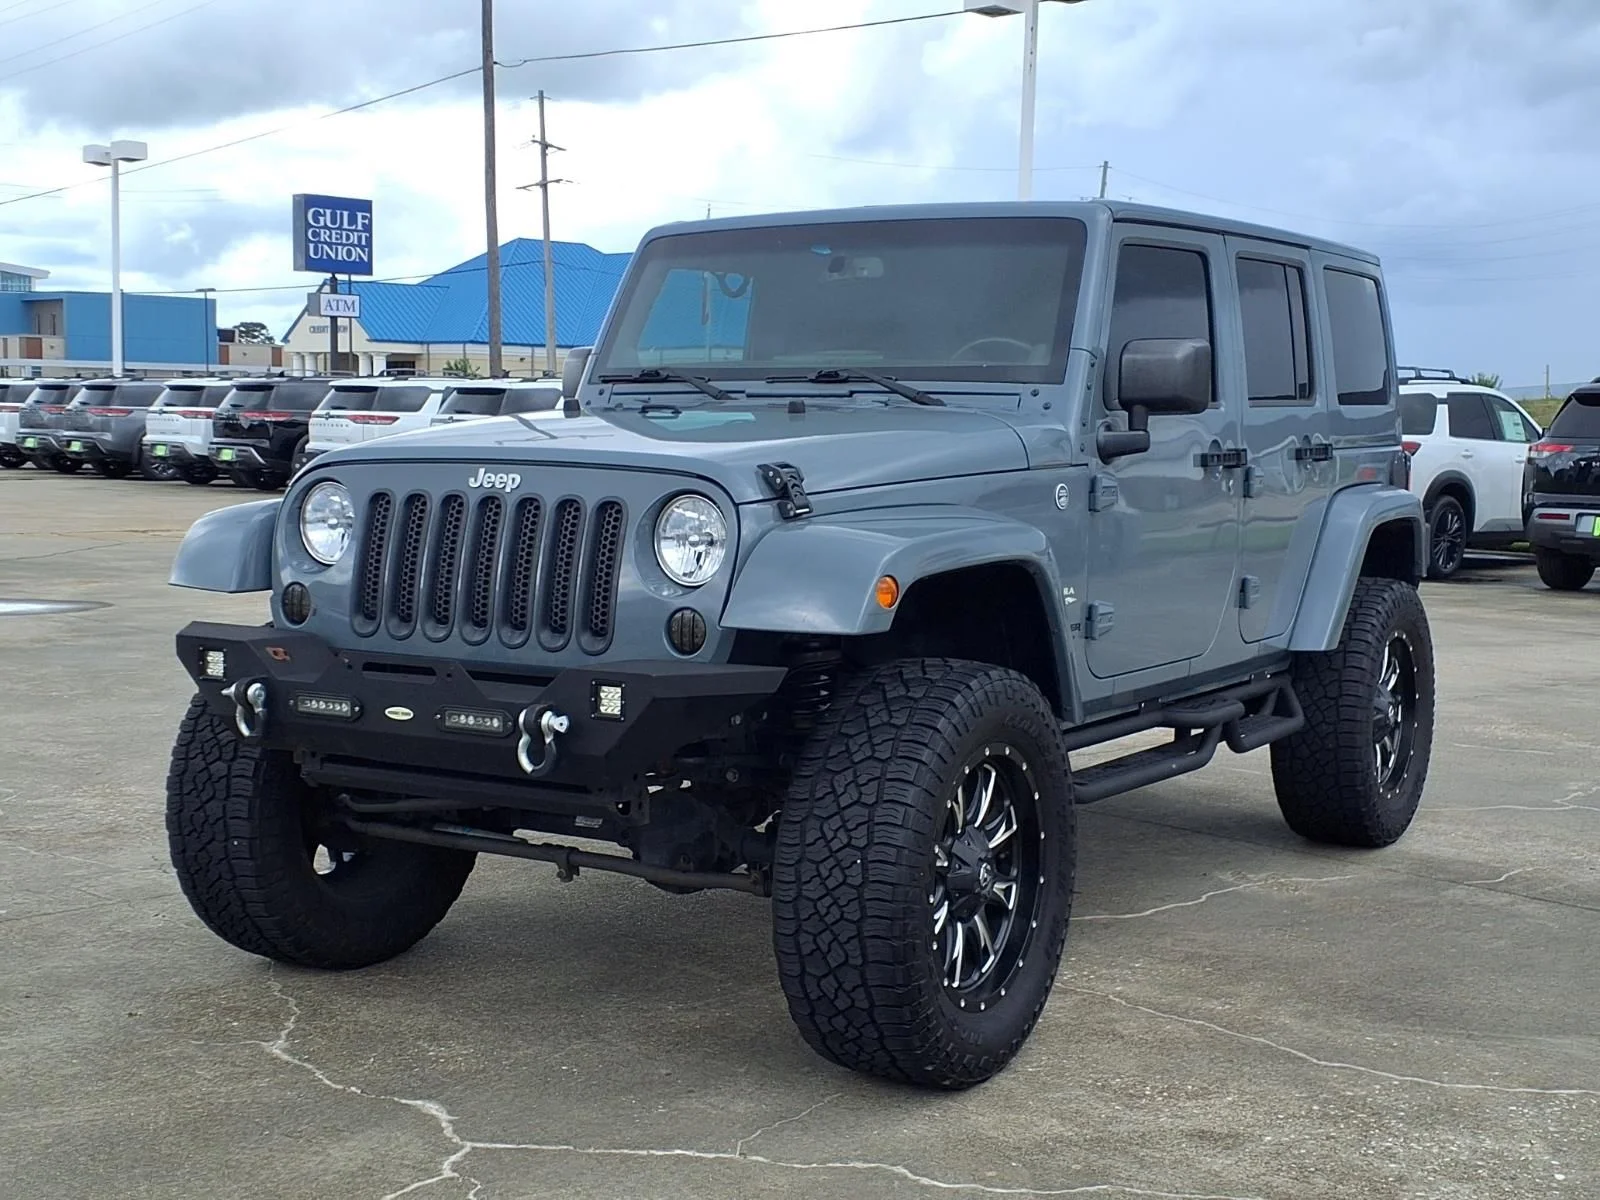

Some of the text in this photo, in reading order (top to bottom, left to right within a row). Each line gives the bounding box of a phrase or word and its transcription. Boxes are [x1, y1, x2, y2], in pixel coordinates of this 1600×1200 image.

[307, 207, 371, 230] GULF
[307, 228, 370, 246] CREDIT
[308, 243, 369, 262] UNION
[324, 299, 356, 313] ATM
[468, 467, 521, 493] Jeep
